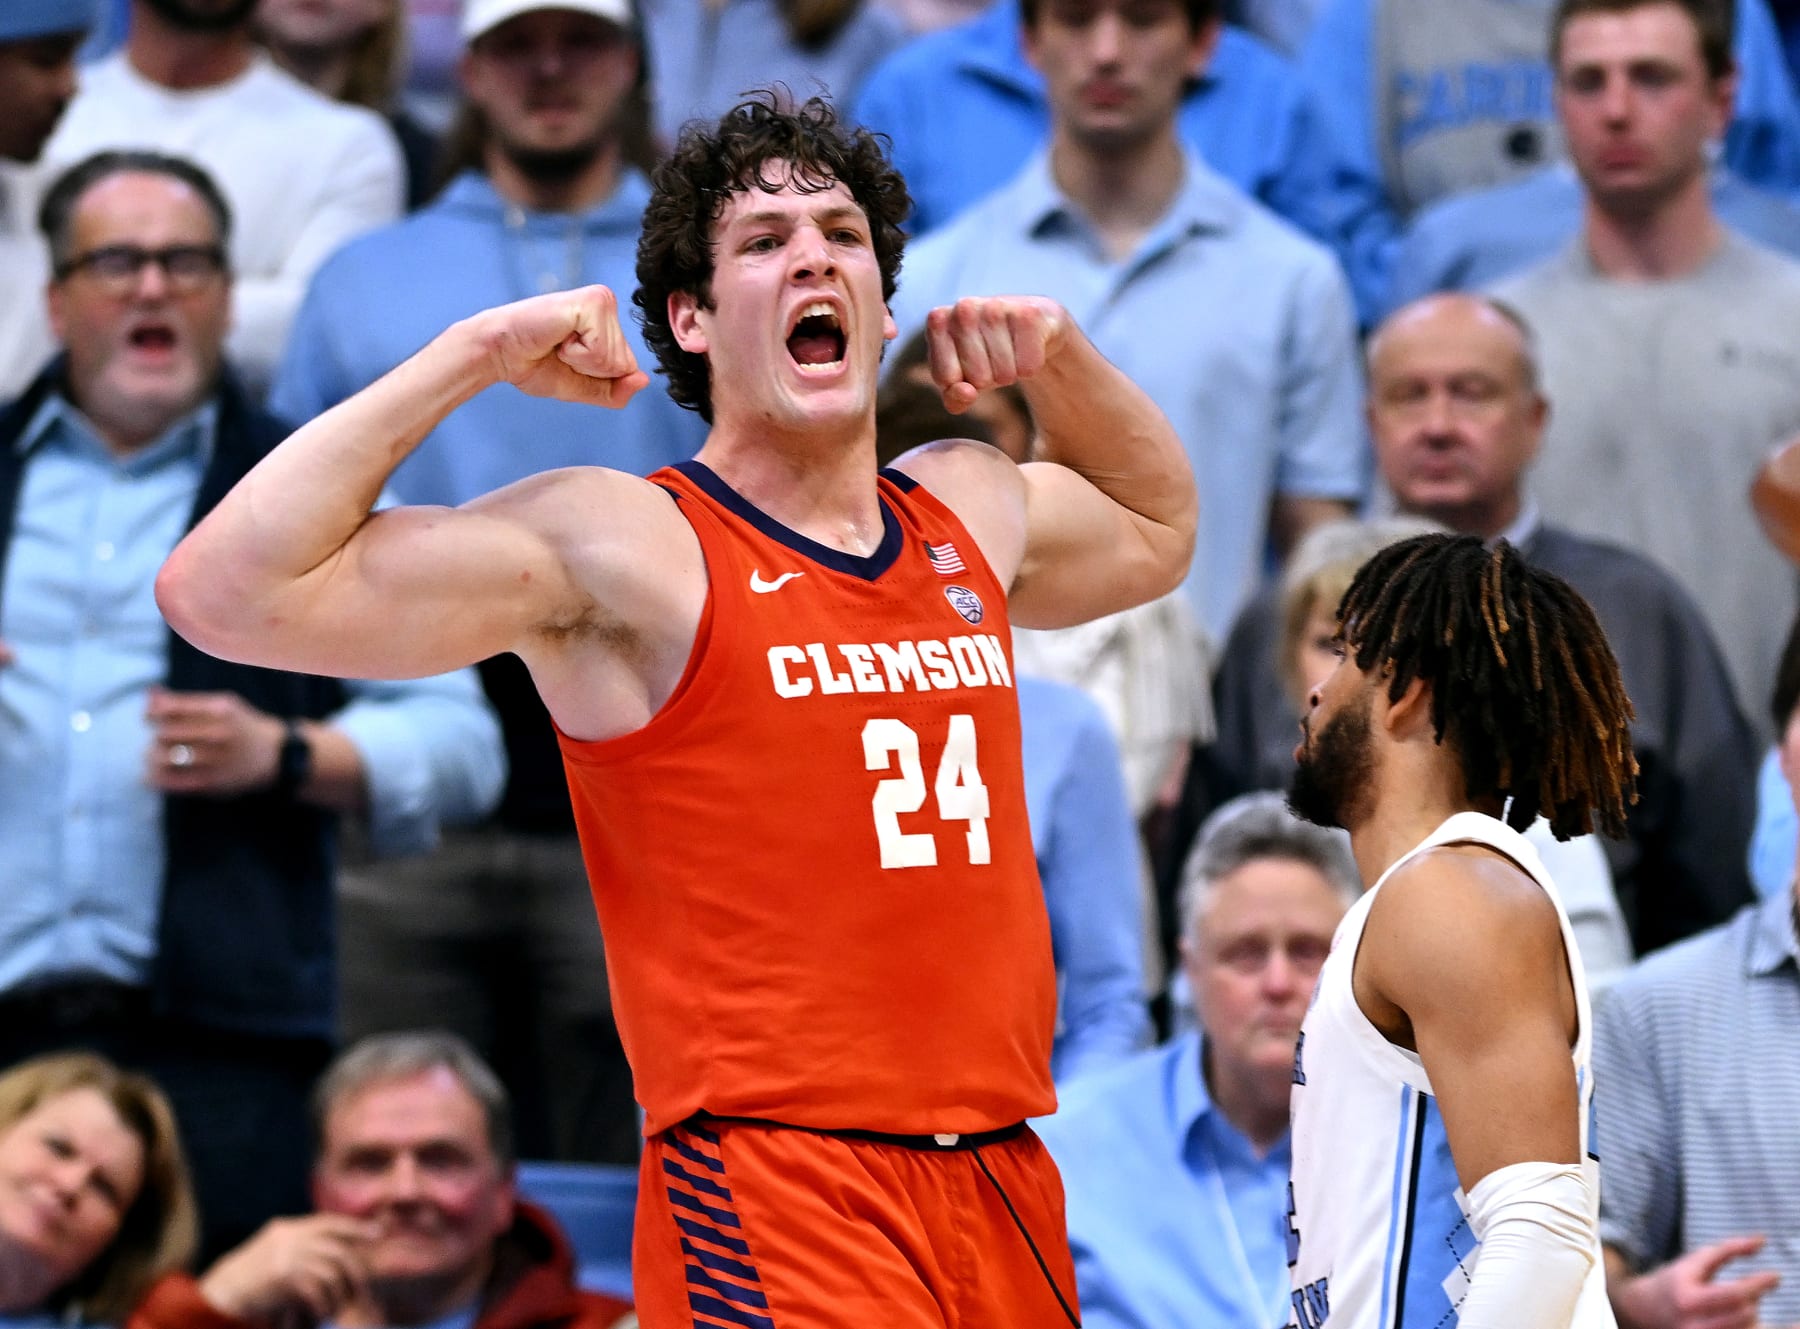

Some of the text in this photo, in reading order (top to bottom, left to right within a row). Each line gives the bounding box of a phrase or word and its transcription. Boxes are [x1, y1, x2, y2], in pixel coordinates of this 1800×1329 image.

[956, 596, 978, 607] ACC
[767, 634, 1013, 699] CLEMSON
[861, 714, 991, 870] 24
